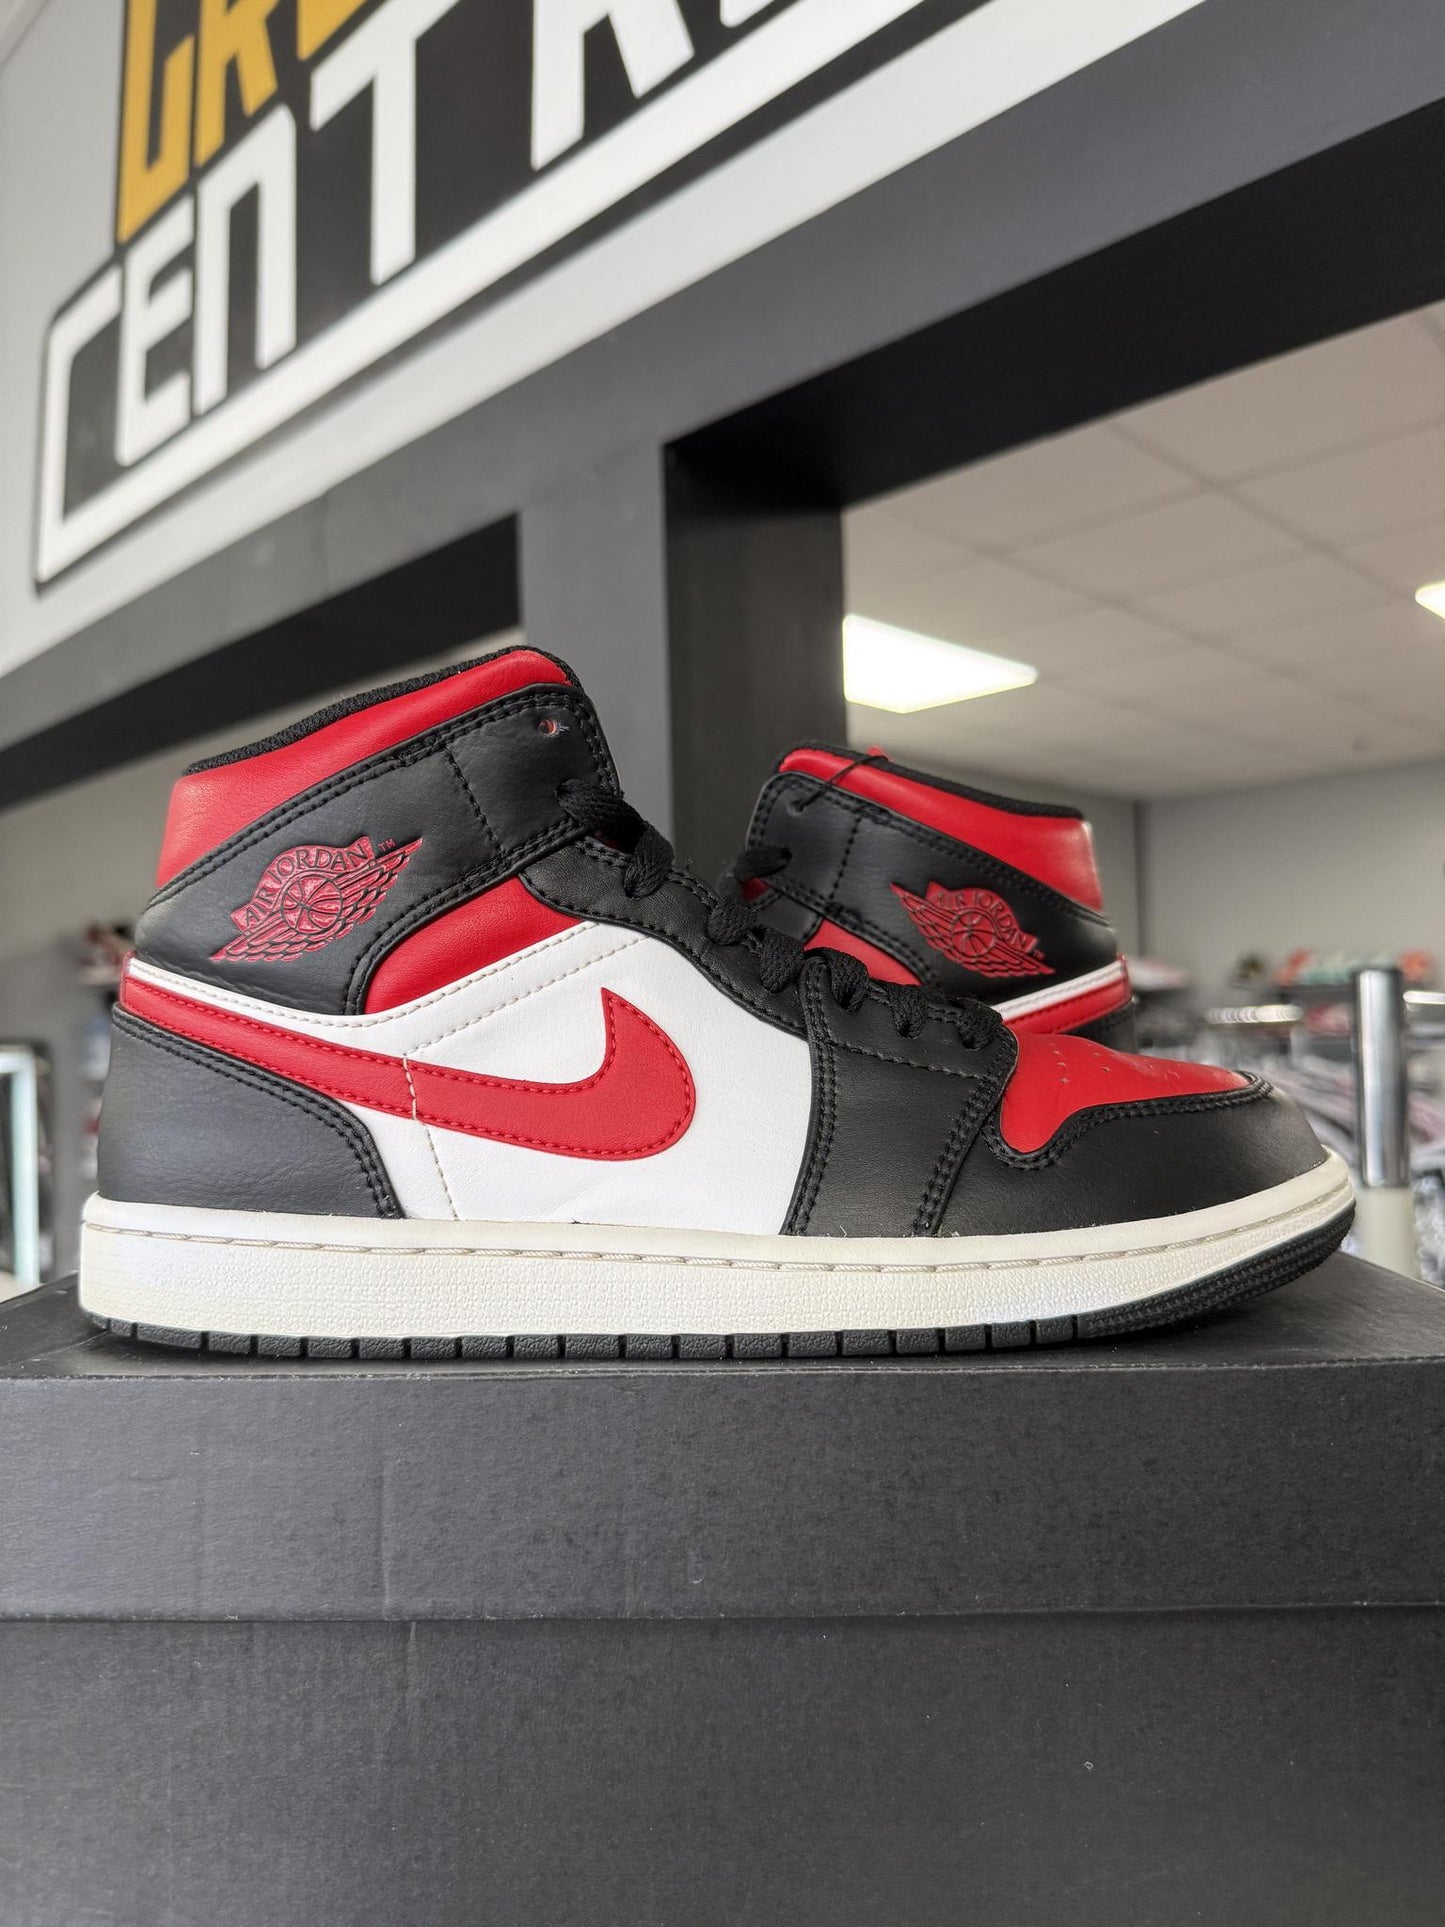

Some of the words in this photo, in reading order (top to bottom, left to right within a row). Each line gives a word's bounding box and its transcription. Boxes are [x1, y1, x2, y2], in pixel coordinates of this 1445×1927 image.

[244, 887, 277, 927] AIR
[268, 843, 368, 885] JORDAN
[936, 890, 968, 910] AIR
[973, 890, 1029, 949] JORDAN
